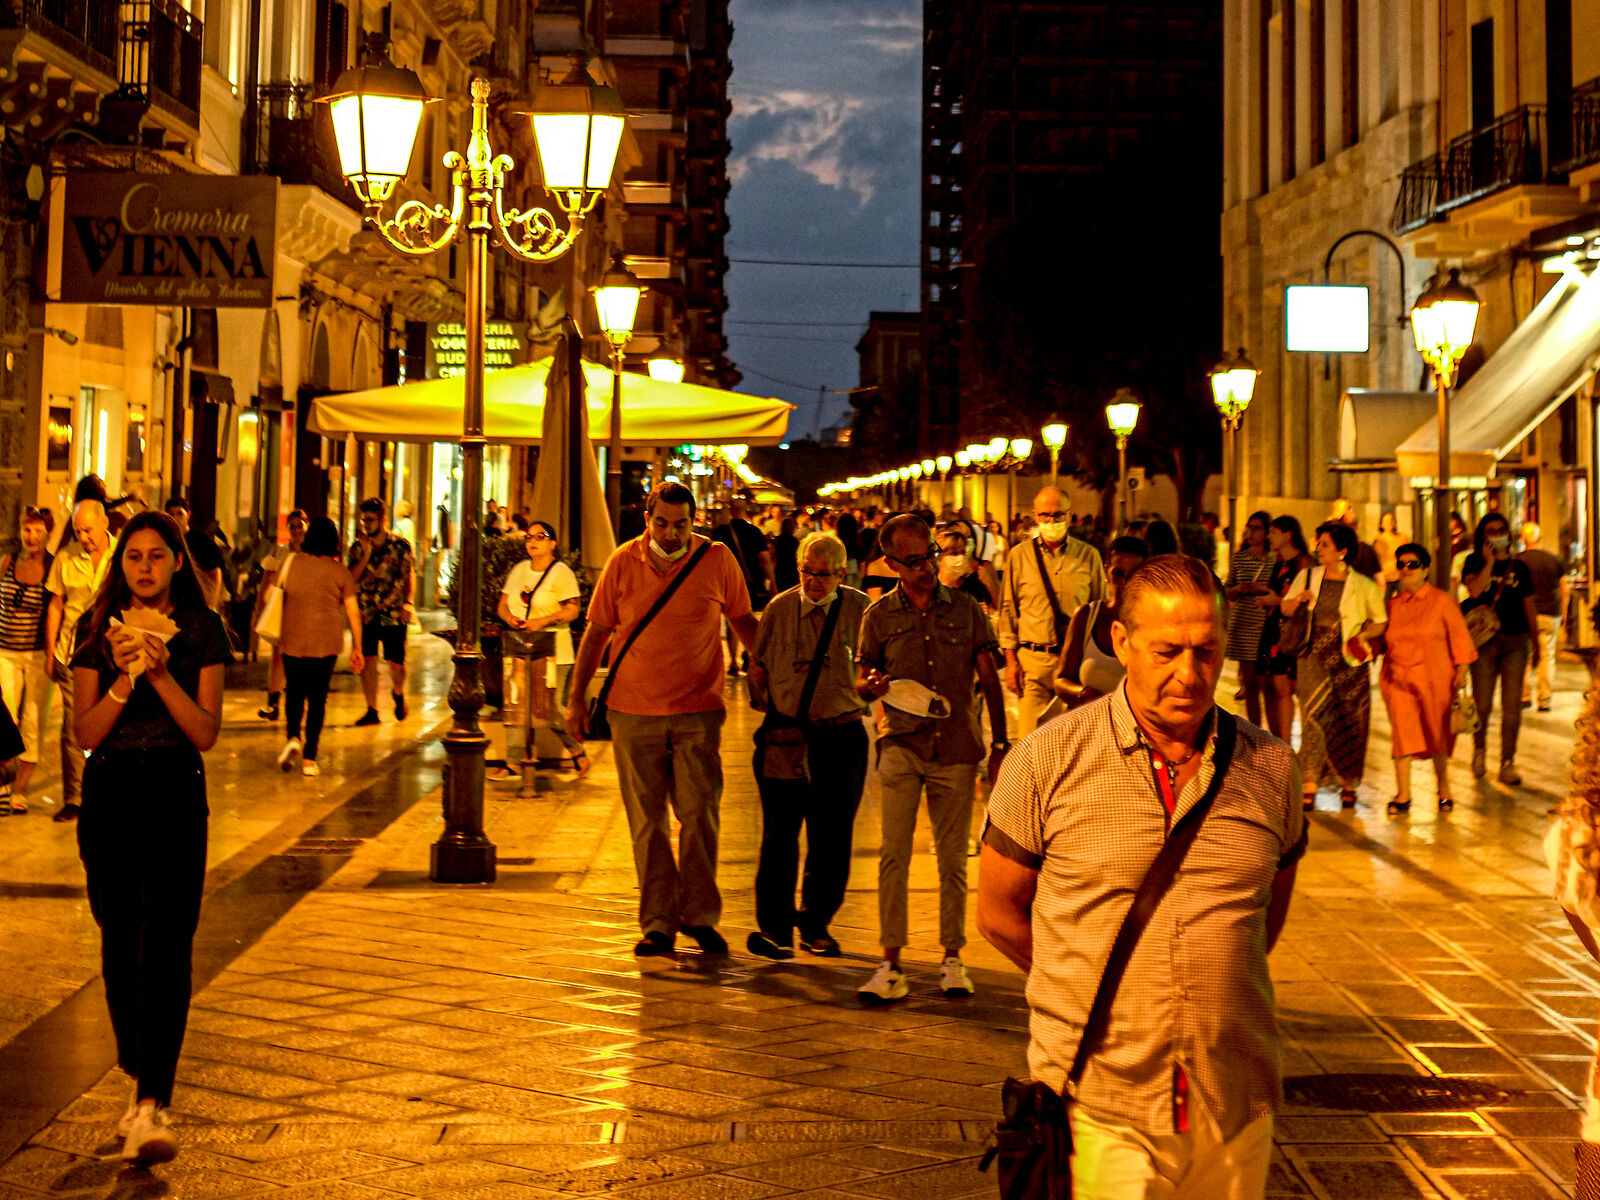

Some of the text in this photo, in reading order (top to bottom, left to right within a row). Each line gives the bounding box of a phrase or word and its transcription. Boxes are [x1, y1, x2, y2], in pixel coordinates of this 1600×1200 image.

[121, 182, 249, 233] Cremeria
[71, 216, 269, 279] VIENNA
[154, 280, 174, 297] del
